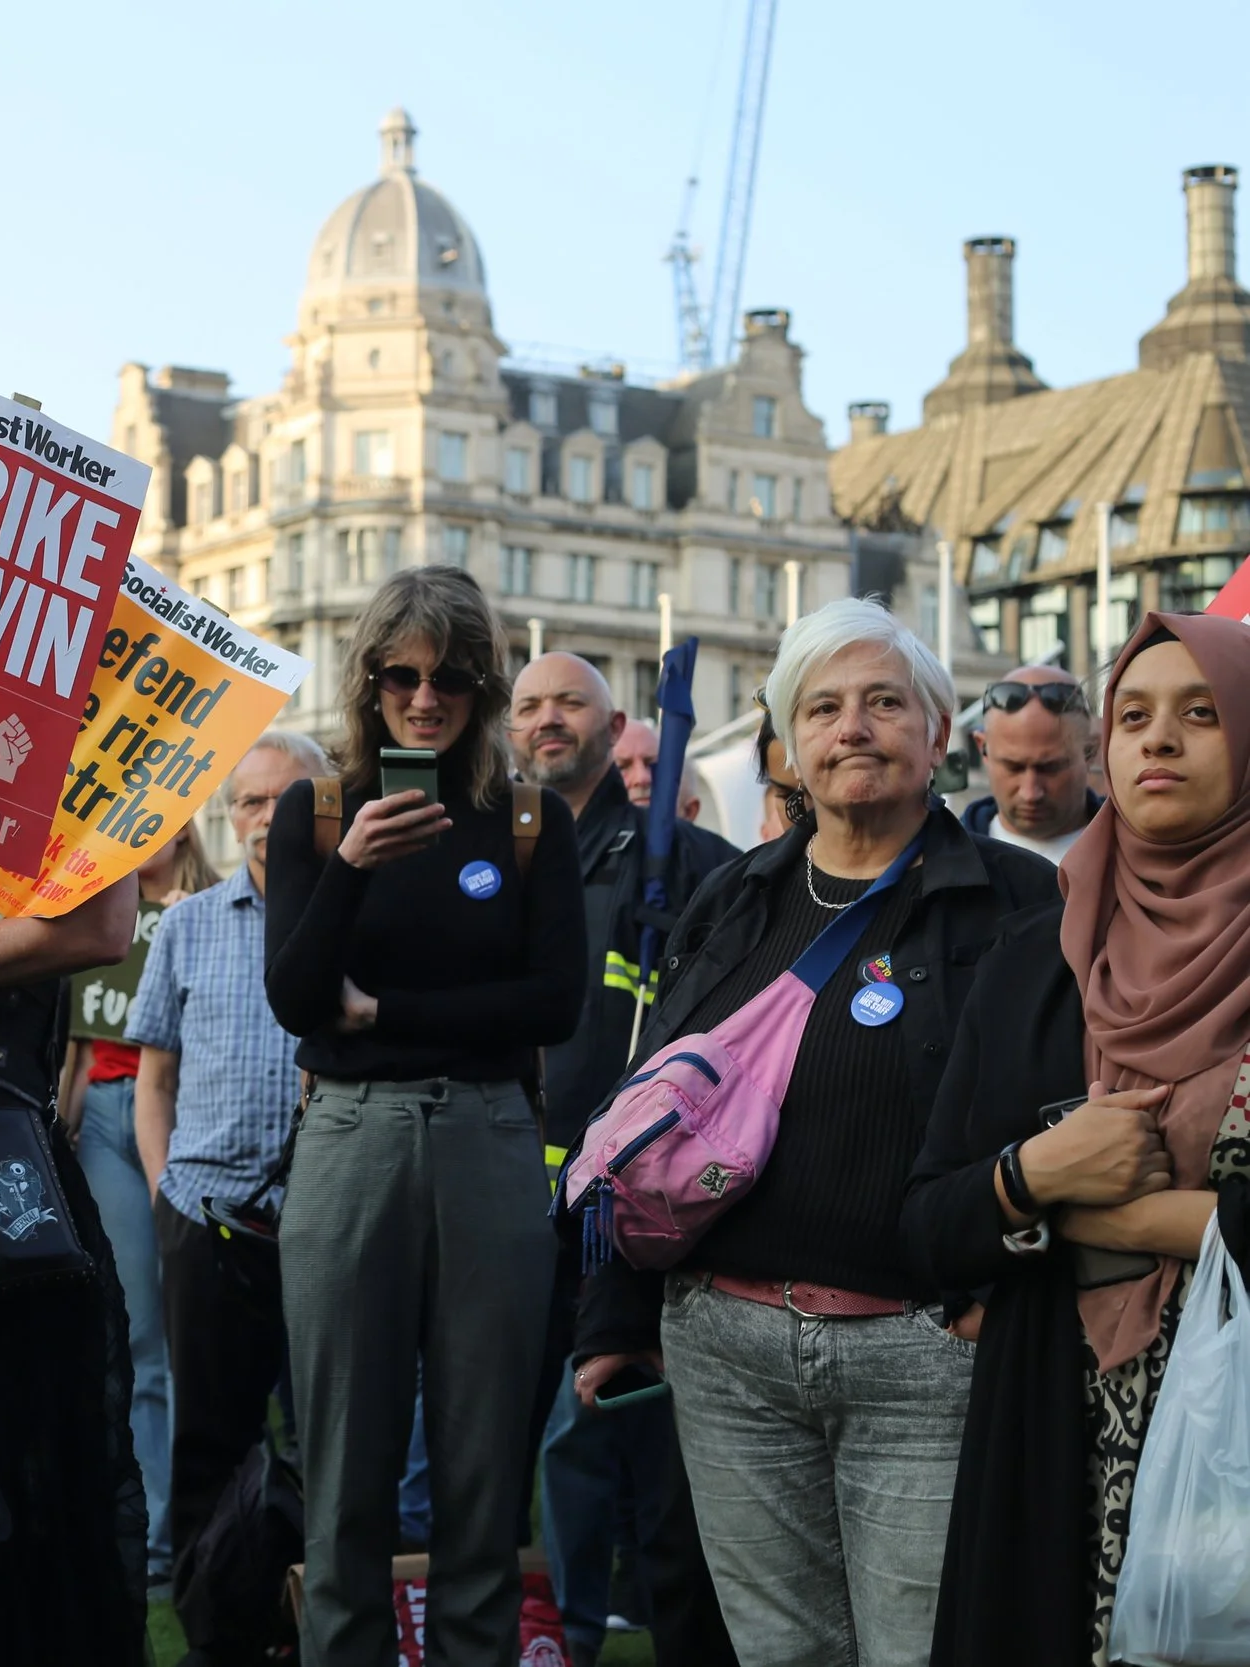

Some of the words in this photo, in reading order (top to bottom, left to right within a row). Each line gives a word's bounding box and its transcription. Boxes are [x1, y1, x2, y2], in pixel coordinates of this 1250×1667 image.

[98, 628, 232, 729] efend
[97, 713, 216, 798] right
[61, 761, 163, 849] trike
[64, 848, 97, 878] the
[875, 958, 886, 968] UP
[882, 967, 892, 977] TO
